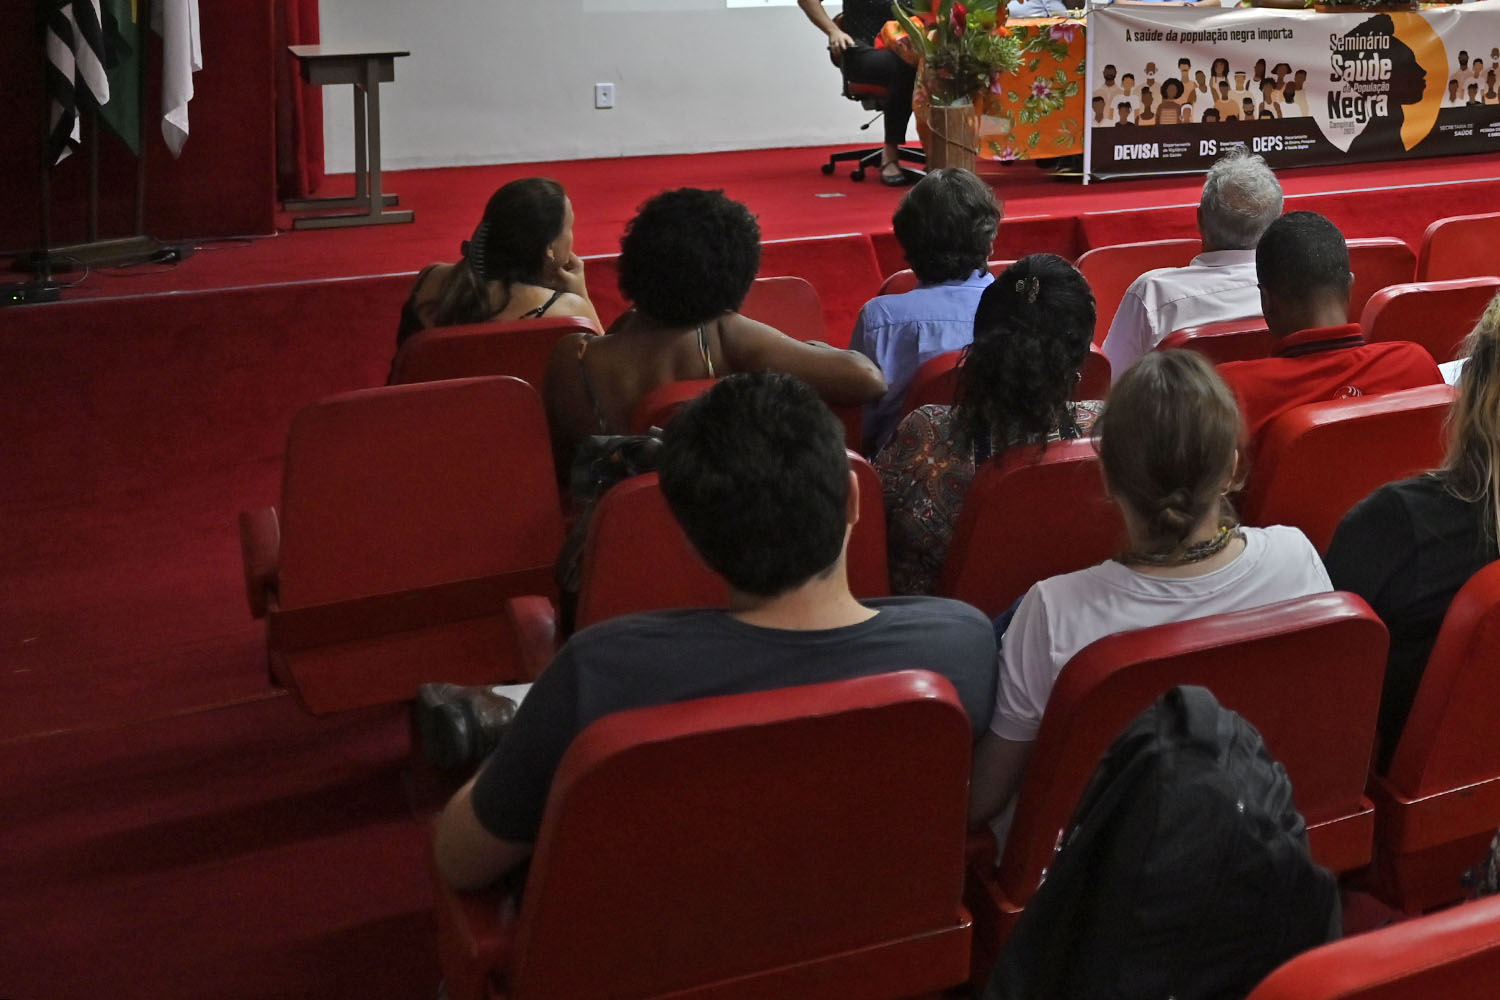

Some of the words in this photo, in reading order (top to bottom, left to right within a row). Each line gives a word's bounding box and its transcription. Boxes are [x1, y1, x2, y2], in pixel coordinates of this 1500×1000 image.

[1125, 28, 1132, 42] A
[1134, 28, 1163, 42] saúde
[1166, 29, 1178, 42] da
[1180, 28, 1228, 44] população
[1230, 29, 1256, 43] negra
[1258, 27, 1293, 42] importa
[1329, 31, 1390, 51] Seminário
[1330, 52, 1392, 82] Saúde
[1353, 82, 1390, 94] População
[1328, 91, 1389, 124] Negra
[1114, 143, 1159, 161] DEVISA
[1199, 139, 1217, 156] DS
[1252, 135, 1283, 152] DEPS
